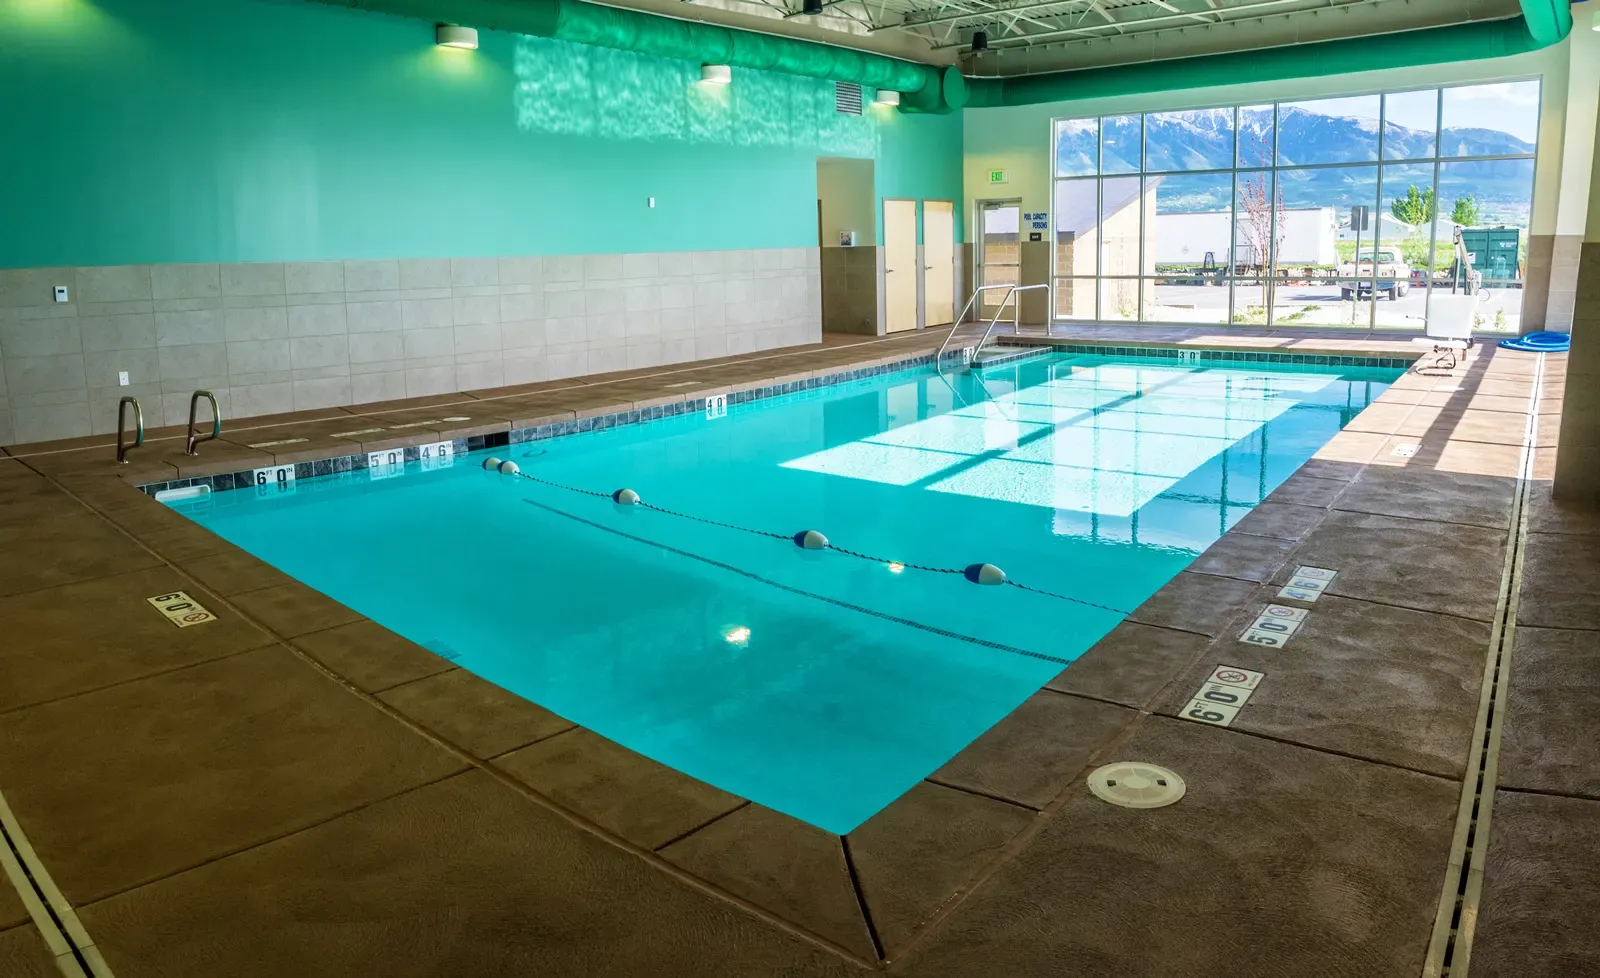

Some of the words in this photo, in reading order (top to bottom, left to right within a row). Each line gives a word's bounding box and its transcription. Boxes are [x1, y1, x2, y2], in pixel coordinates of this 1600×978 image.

[991, 171, 1003, 182] EXIT
[1023, 213, 1032, 221] POOL
[1032, 212, 1048, 220] CAPACITY
[1032, 221, 1048, 229] PERSONS
